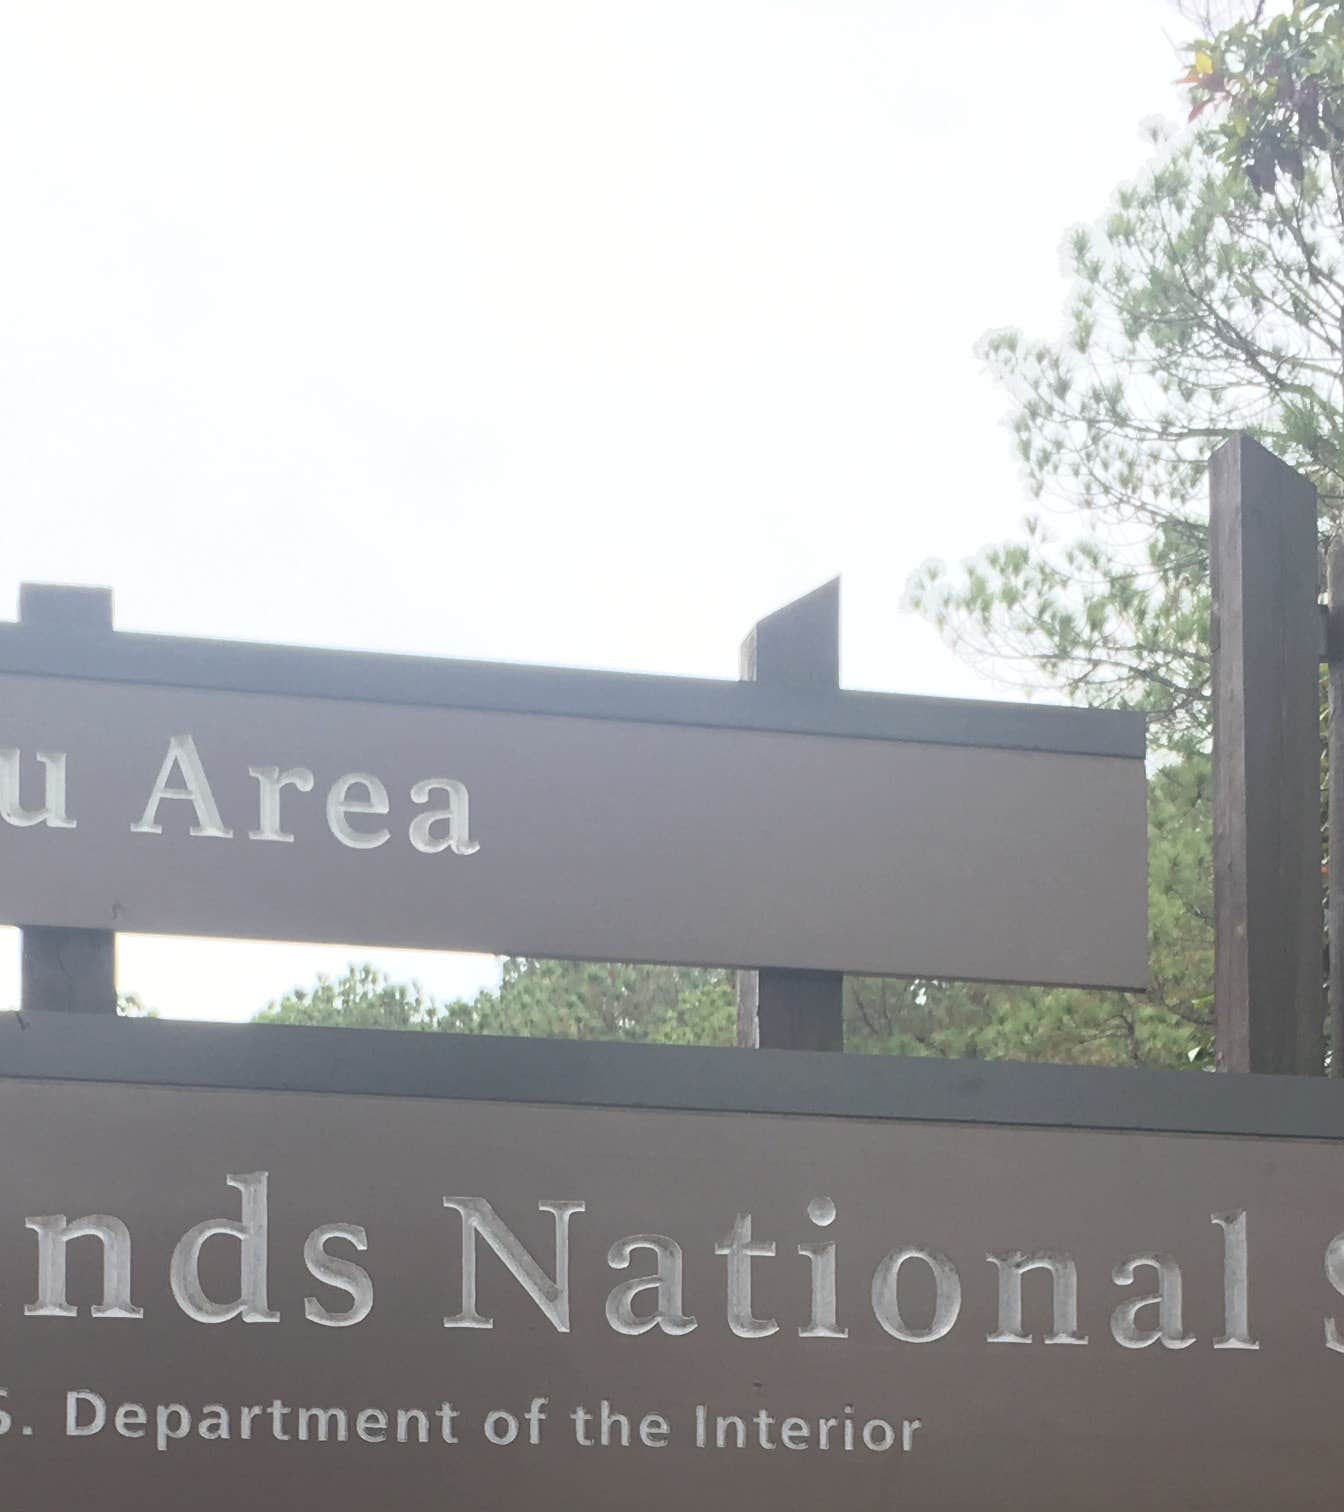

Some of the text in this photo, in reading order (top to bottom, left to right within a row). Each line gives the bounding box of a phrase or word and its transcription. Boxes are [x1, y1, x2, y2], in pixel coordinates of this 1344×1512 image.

[131, 734, 480, 855] Area
[443, 1197, 1259, 1349] National
[67, 1392, 459, 1450] Department
[484, 1398, 548, 1445] of
[570, 1400, 670, 1447] the
[696, 1405, 921, 1451] Interior
